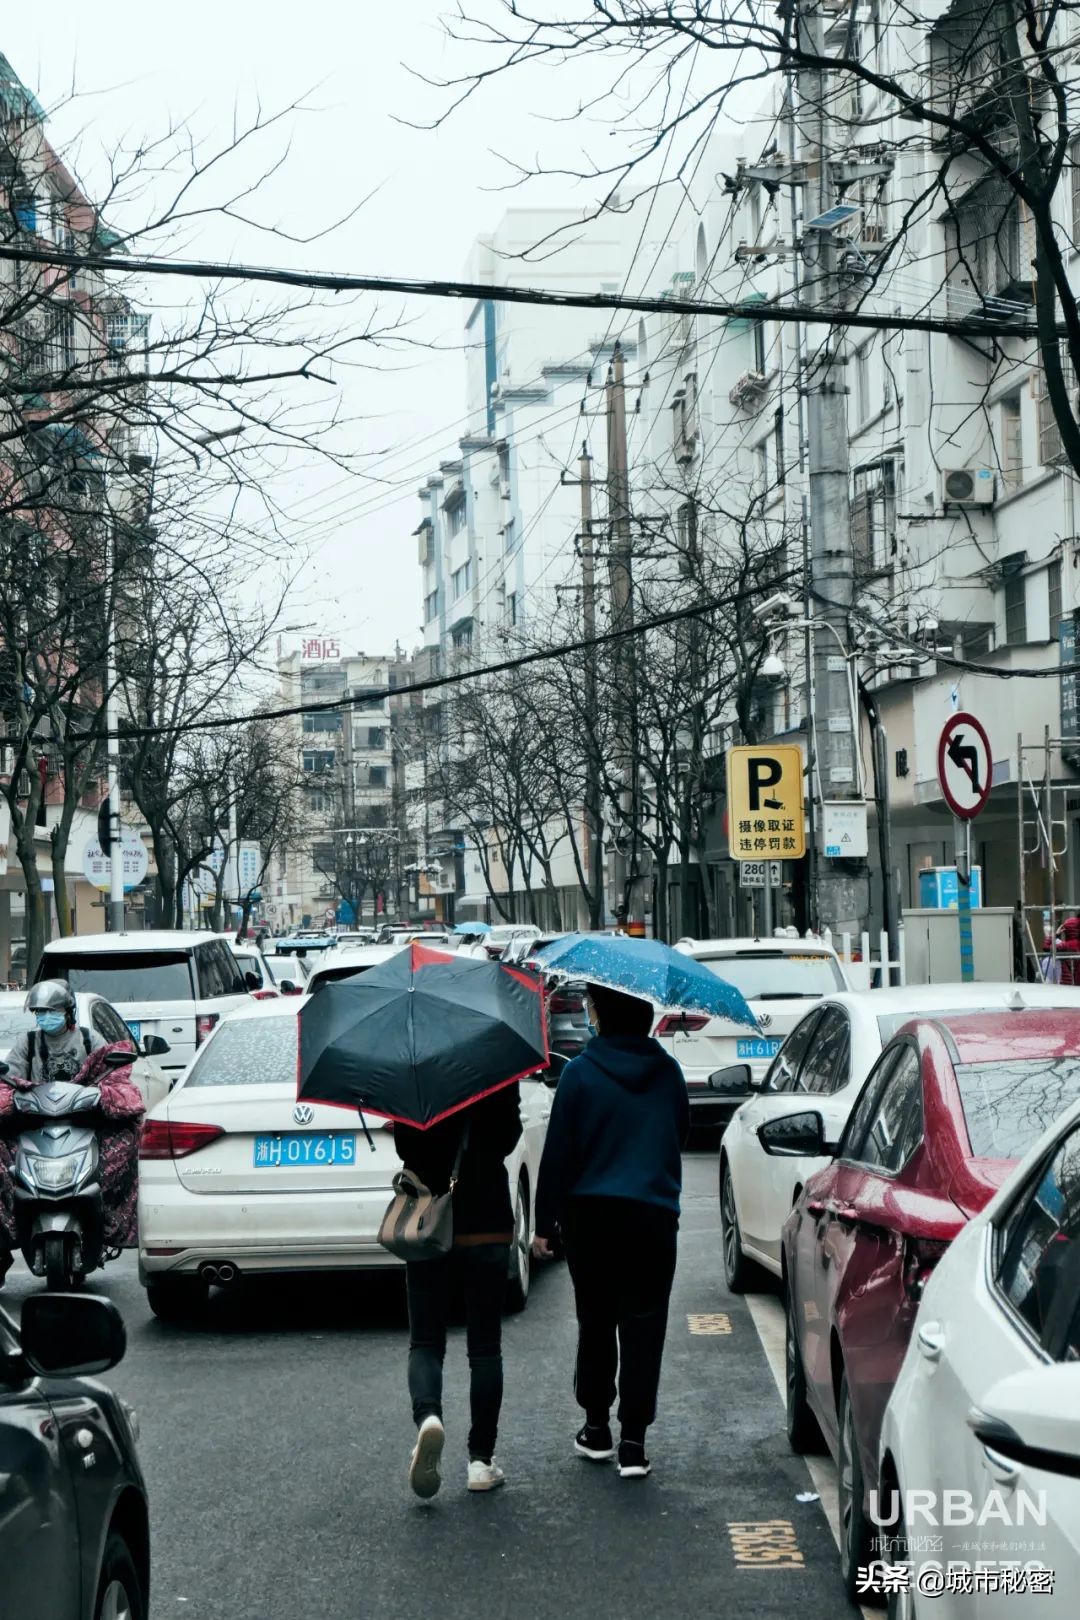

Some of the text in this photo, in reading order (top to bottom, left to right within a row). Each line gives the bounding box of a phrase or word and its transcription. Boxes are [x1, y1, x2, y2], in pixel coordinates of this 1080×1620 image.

[302, 639, 341, 659] 酒店
[747, 757, 783, 811] P
[738, 818, 796, 834] 摄像取证
[739, 837, 797, 852] 违停罚款
[727, 1519, 806, 1569] 158351
